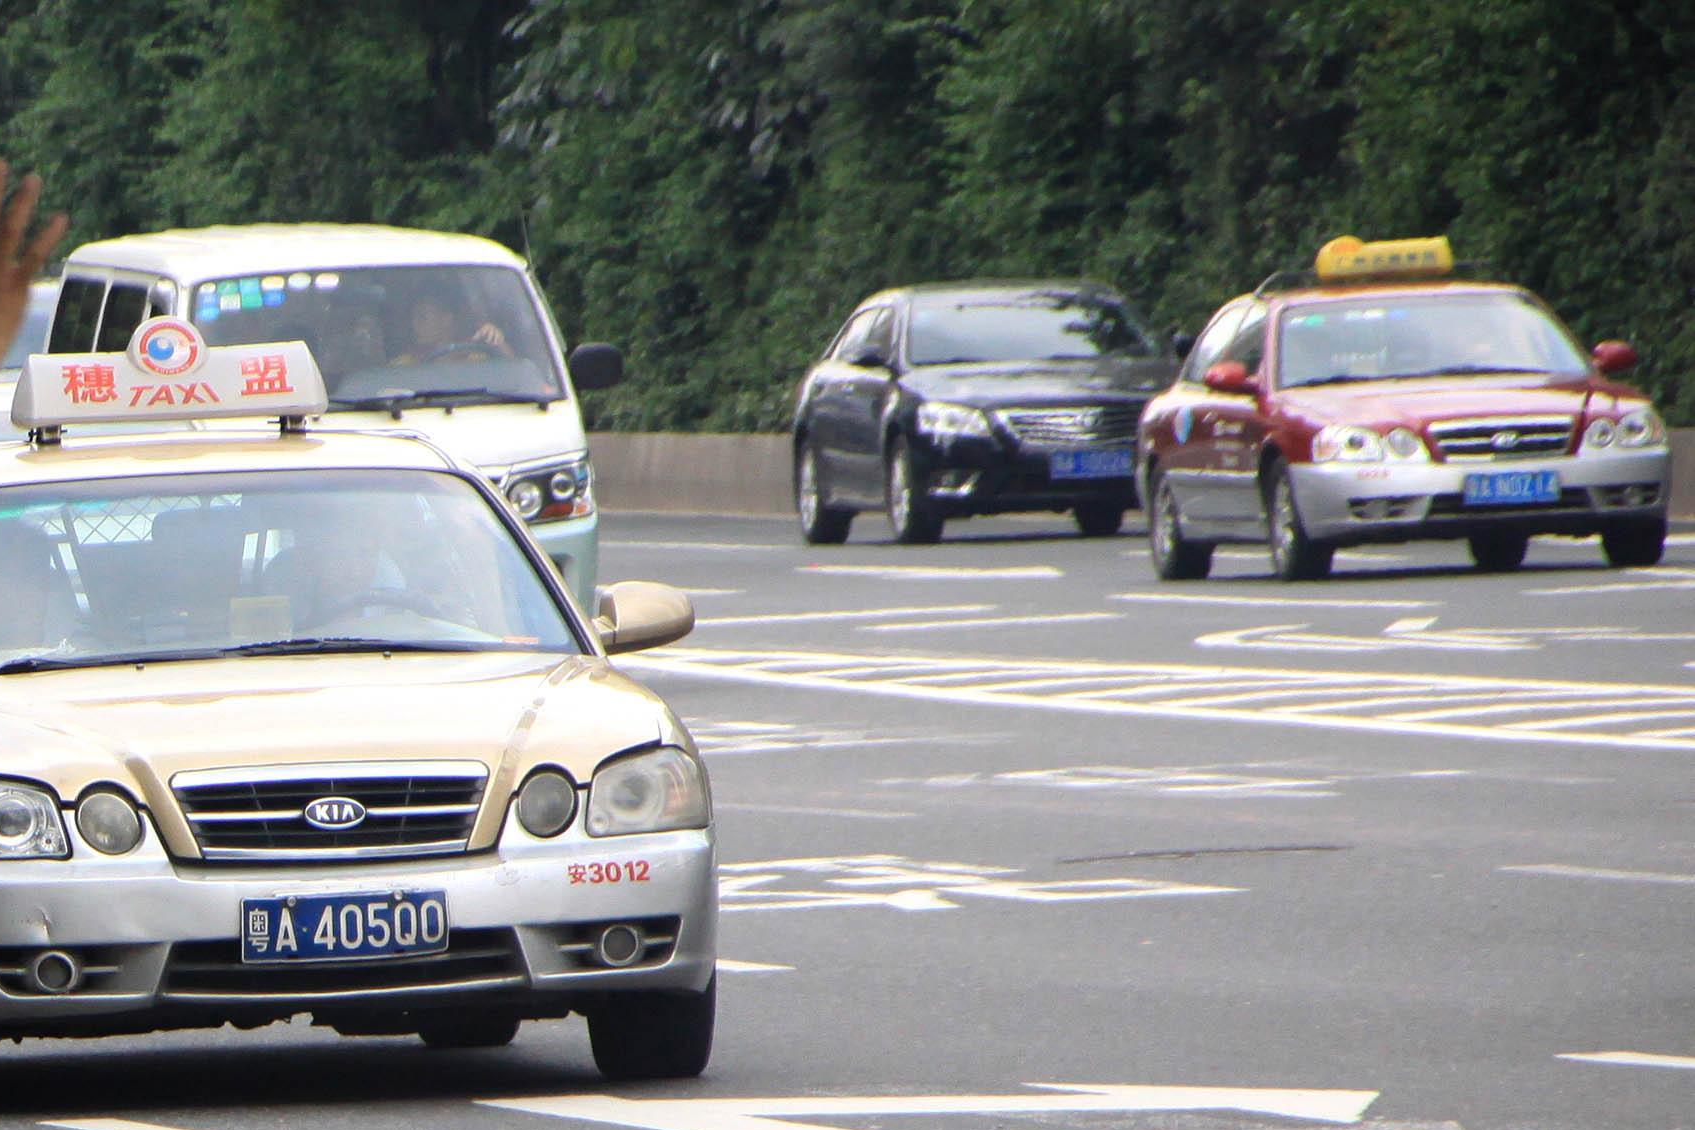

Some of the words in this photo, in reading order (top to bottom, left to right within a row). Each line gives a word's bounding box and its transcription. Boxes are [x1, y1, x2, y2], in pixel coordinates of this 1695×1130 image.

[62, 363, 117, 404] 穗
[129, 382, 220, 407] TAXI
[241, 354, 294, 396] 盟
[315, 804, 356, 820] KIA
[567, 860, 651, 884] 安3012
